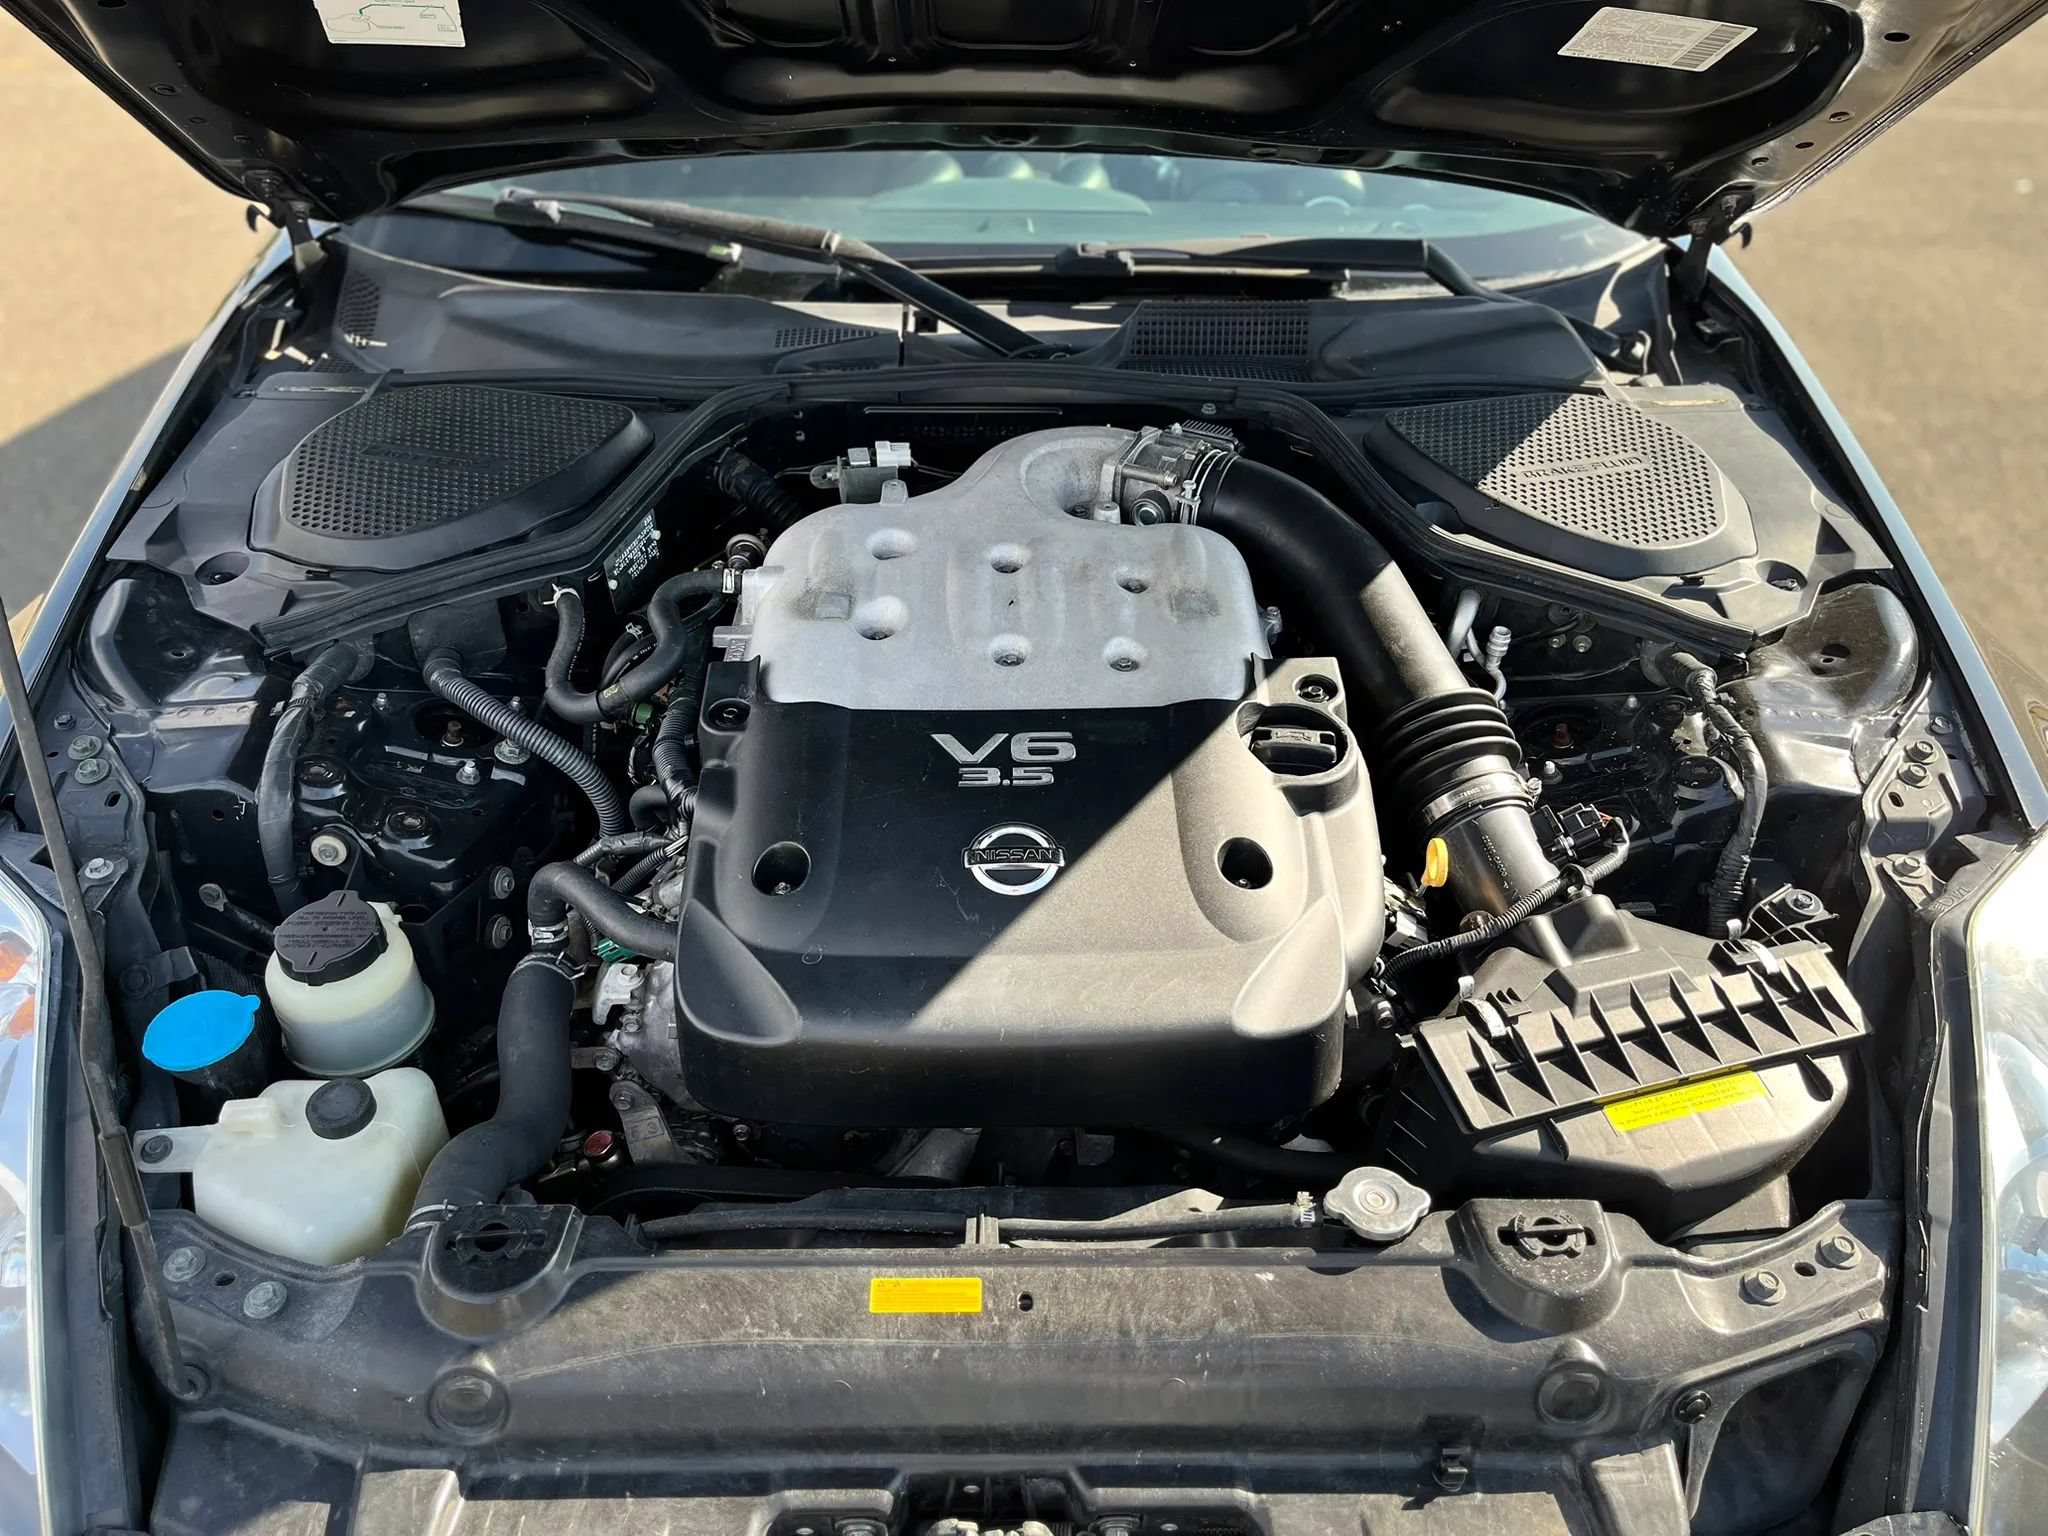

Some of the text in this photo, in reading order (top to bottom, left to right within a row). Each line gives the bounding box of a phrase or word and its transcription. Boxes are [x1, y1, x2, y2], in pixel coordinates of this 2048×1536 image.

[1521, 456, 1642, 479] BRAKE FLUID
[931, 731, 1077, 764] V6
[958, 766, 1054, 787] 3.5
[975, 848, 1053, 862] NISSAN
